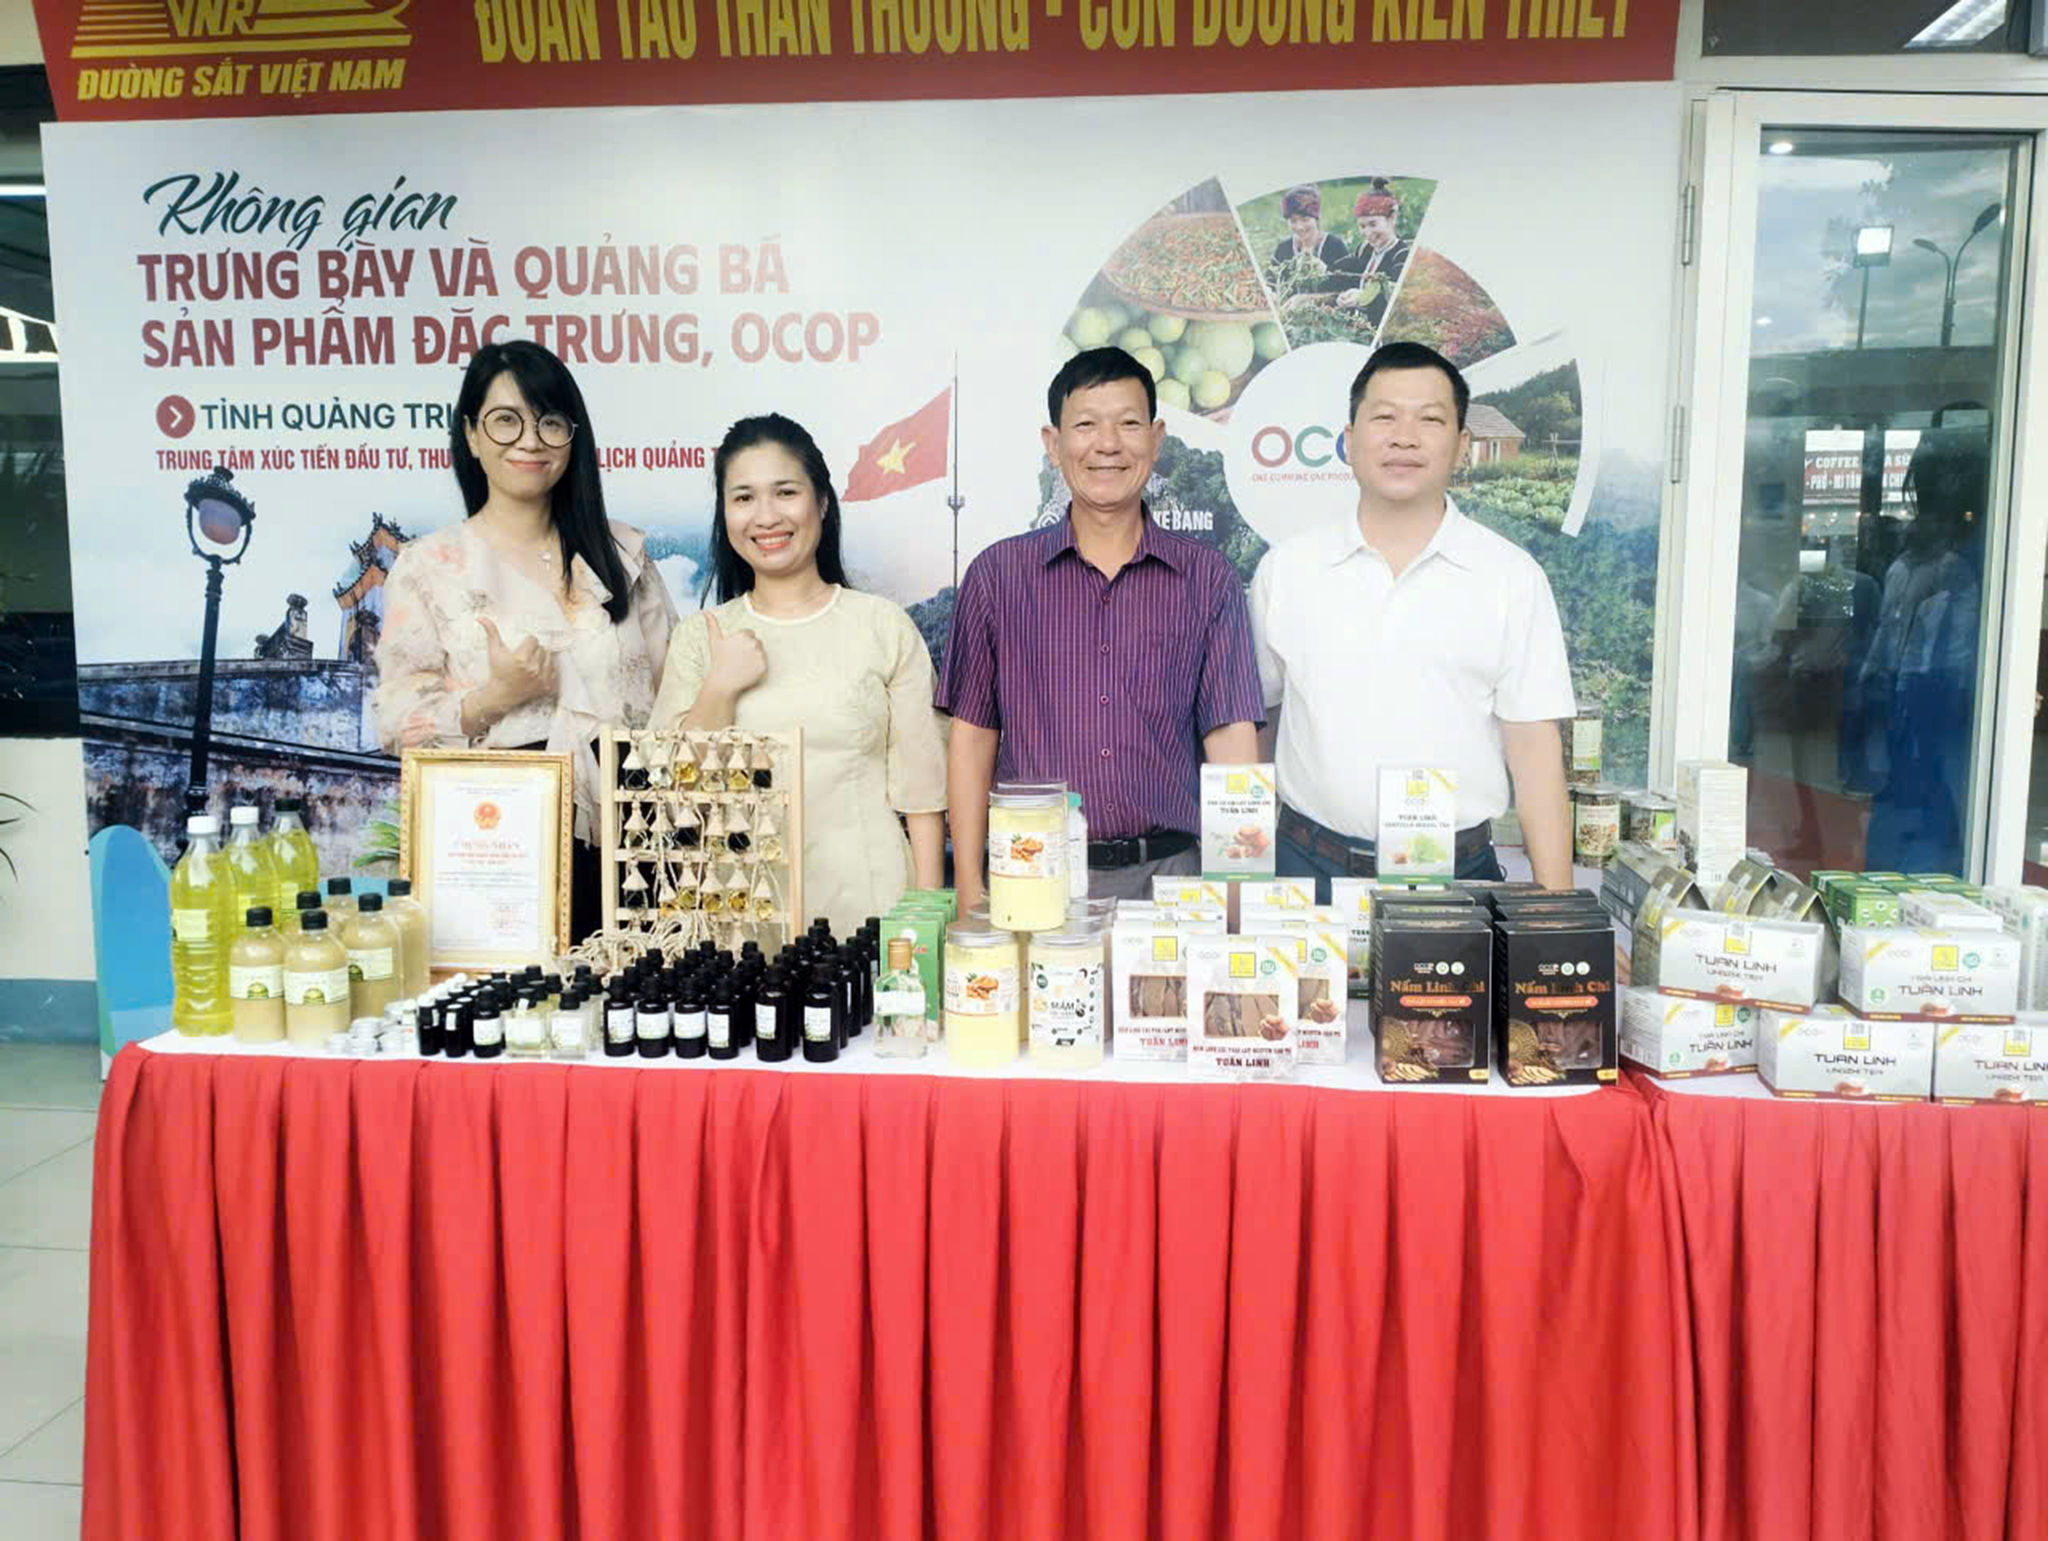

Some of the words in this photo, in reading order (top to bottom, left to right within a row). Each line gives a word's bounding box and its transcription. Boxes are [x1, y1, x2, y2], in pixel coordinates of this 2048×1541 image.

[167, 0, 254, 37] VNR
[192, 57, 254, 98] SẮT
[260, 57, 324, 98] VIỆT
[328, 59, 406, 91] NAM
[143, 170, 325, 250] Không
[137, 247, 300, 301] TRƯNG
[429, 237, 499, 297] VÀ
[514, 232, 700, 300] QUẢNG
[719, 234, 791, 295] BÁ
[142, 307, 234, 368] SẢN
[252, 297, 396, 366] PHẨM
[730, 311, 880, 363] OCOP
[156, 449, 212, 470] TRUNG
[217, 446, 255, 470] TÂM
[261, 446, 295, 469] XÚC
[300, 442, 340, 469] TIẾN
[643, 441, 705, 471] QUẢNG
[1251, 425, 1348, 468] OC
[1695, 953, 1739, 969] TUAN
[1743, 957, 1777, 973] LINH
[1389, 979, 1423, 993] Nấm
[1515, 980, 1548, 995] Nấm
[1948, 985, 1984, 997] LINH
[1727, 1039, 1754, 1051] LINH
[1245, 1058, 1270, 1067] LINH
[1814, 1053, 1860, 1065] TUAN
[1863, 1056, 1896, 1067] LINH
[1973, 1060, 2019, 1071] TUAN
